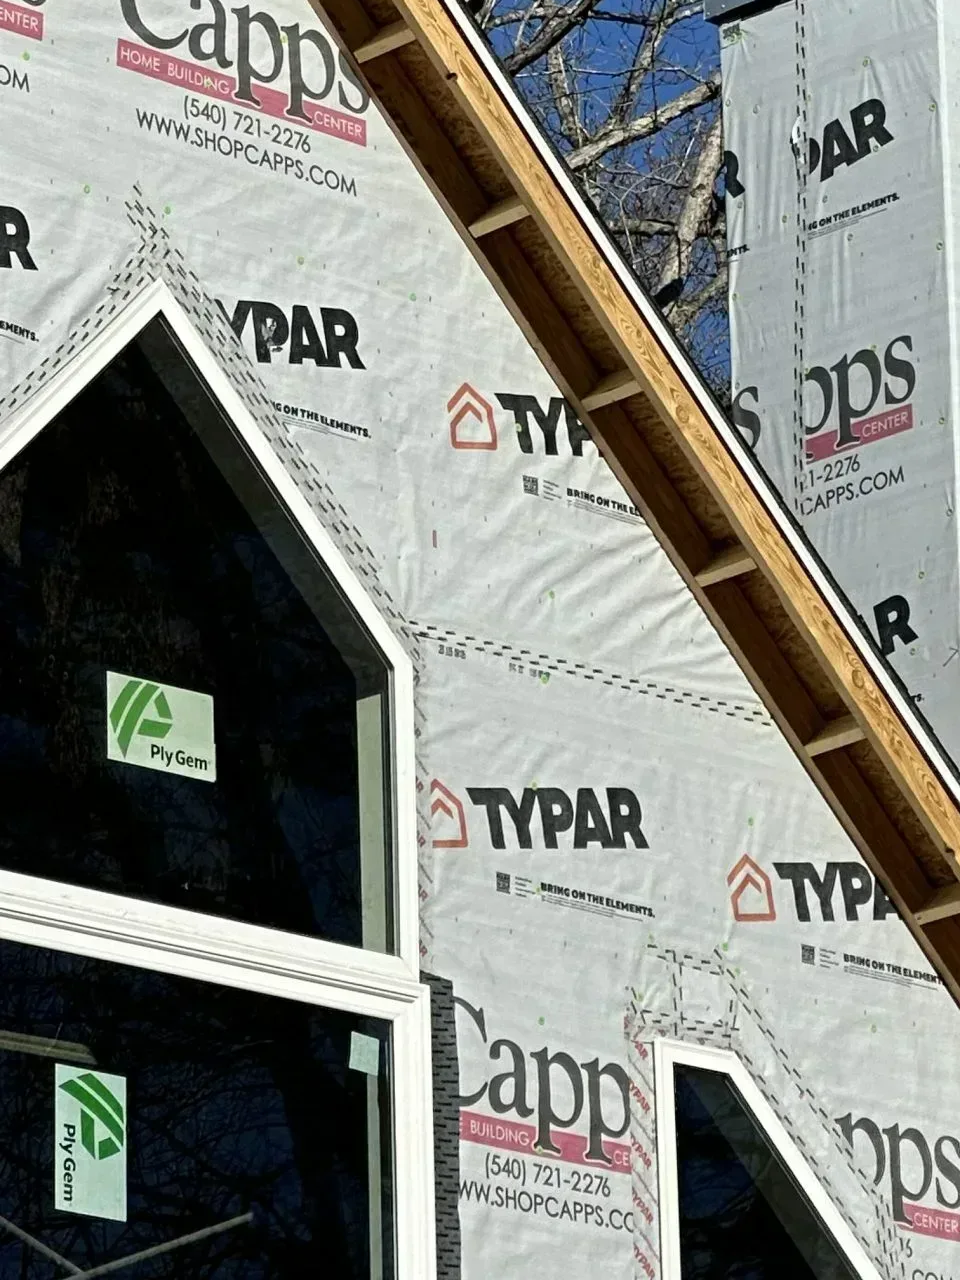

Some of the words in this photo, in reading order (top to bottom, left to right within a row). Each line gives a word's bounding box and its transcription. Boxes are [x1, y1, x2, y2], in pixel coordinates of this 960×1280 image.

[120, 47, 161, 71] HOME
[168, 62, 230, 95] BUILDING
[314, 110, 363, 138] CENTER
[184, 95, 226, 131] (540)
[233, 111, 311, 153] 721-2276
[136, 108, 357, 197] WWW.SHOPCAPPS.COM
[819, 216, 832, 227] ON
[833, 209, 850, 222] THE
[283, 405, 299, 416] ON
[300, 409, 319, 423] THE
[494, 393, 604, 458] TYP
[862, 411, 909, 438] CENTER
[566, 488, 595, 504] BRING
[596, 496, 610, 508] ON
[611, 500, 628, 513] THE
[465, 787, 650, 849] TYPAR
[541, 882, 570, 897] BRING
[571, 888, 586, 901] ON
[587, 893, 604, 906] THE
[843, 953, 870, 968] BRING
[871, 960, 885, 971] ON
[886, 963, 902, 976] THE
[470, 1120, 530, 1145] BUILDING
[485, 1152, 527, 1187] (540)
[533, 1163, 611, 1198] 721-2276
[913, 1212, 959, 1234] CENTER
